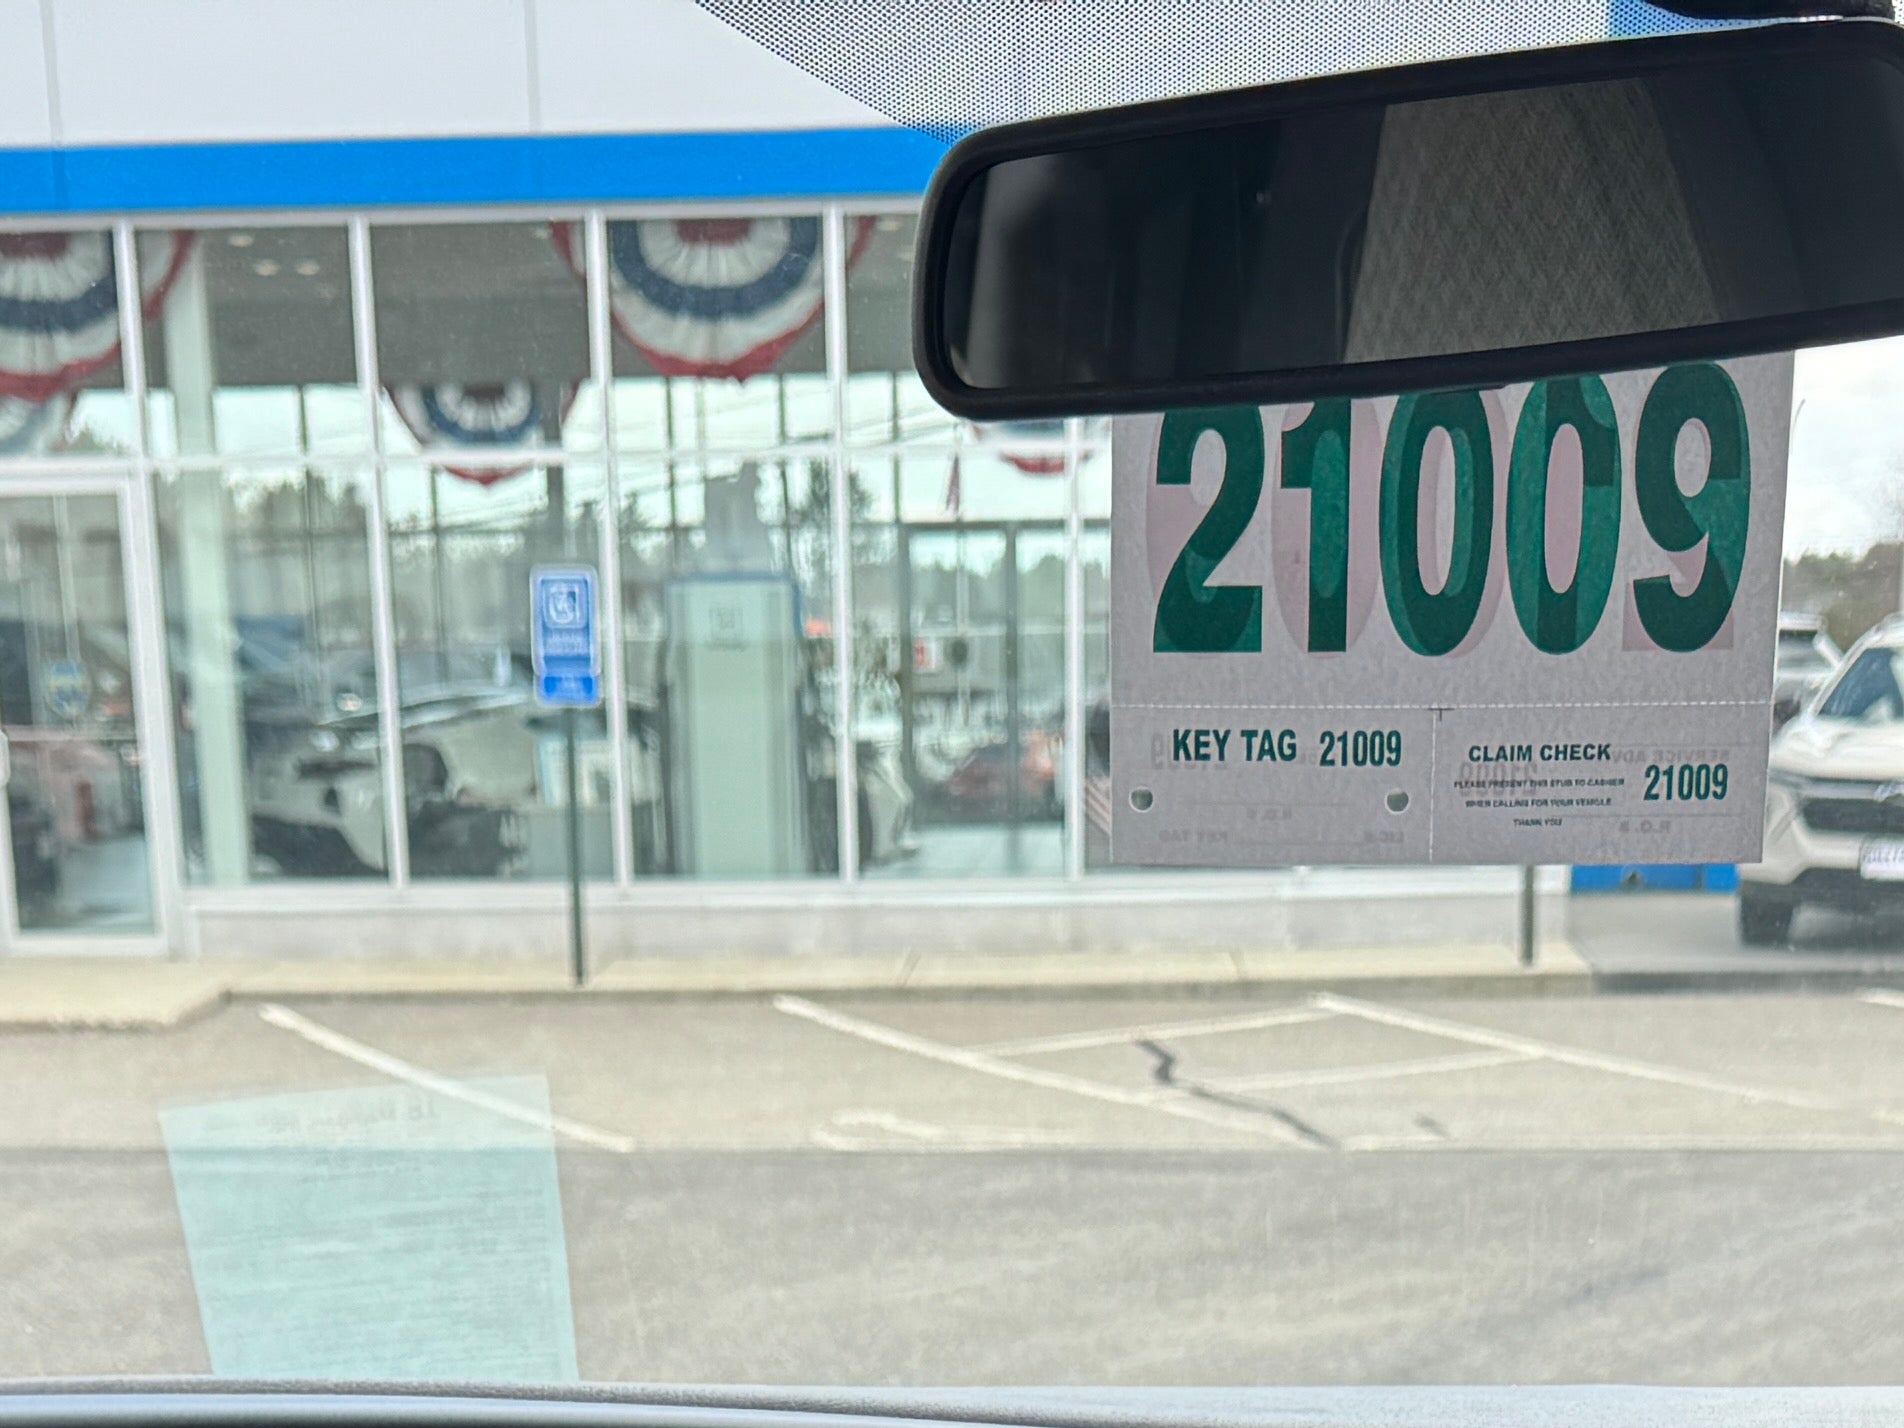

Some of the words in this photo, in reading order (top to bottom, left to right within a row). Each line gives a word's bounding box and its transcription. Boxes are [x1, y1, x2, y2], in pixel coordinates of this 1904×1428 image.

[1153, 361, 1752, 656] 21009
[1173, 728, 1231, 761] KEY
[1241, 729, 1296, 761] TAG
[1319, 730, 1402, 766] 21009
[1468, 744, 1533, 762] CLAIM
[1540, 743, 1612, 761] CHECK
[1643, 763, 1729, 800] 21009
